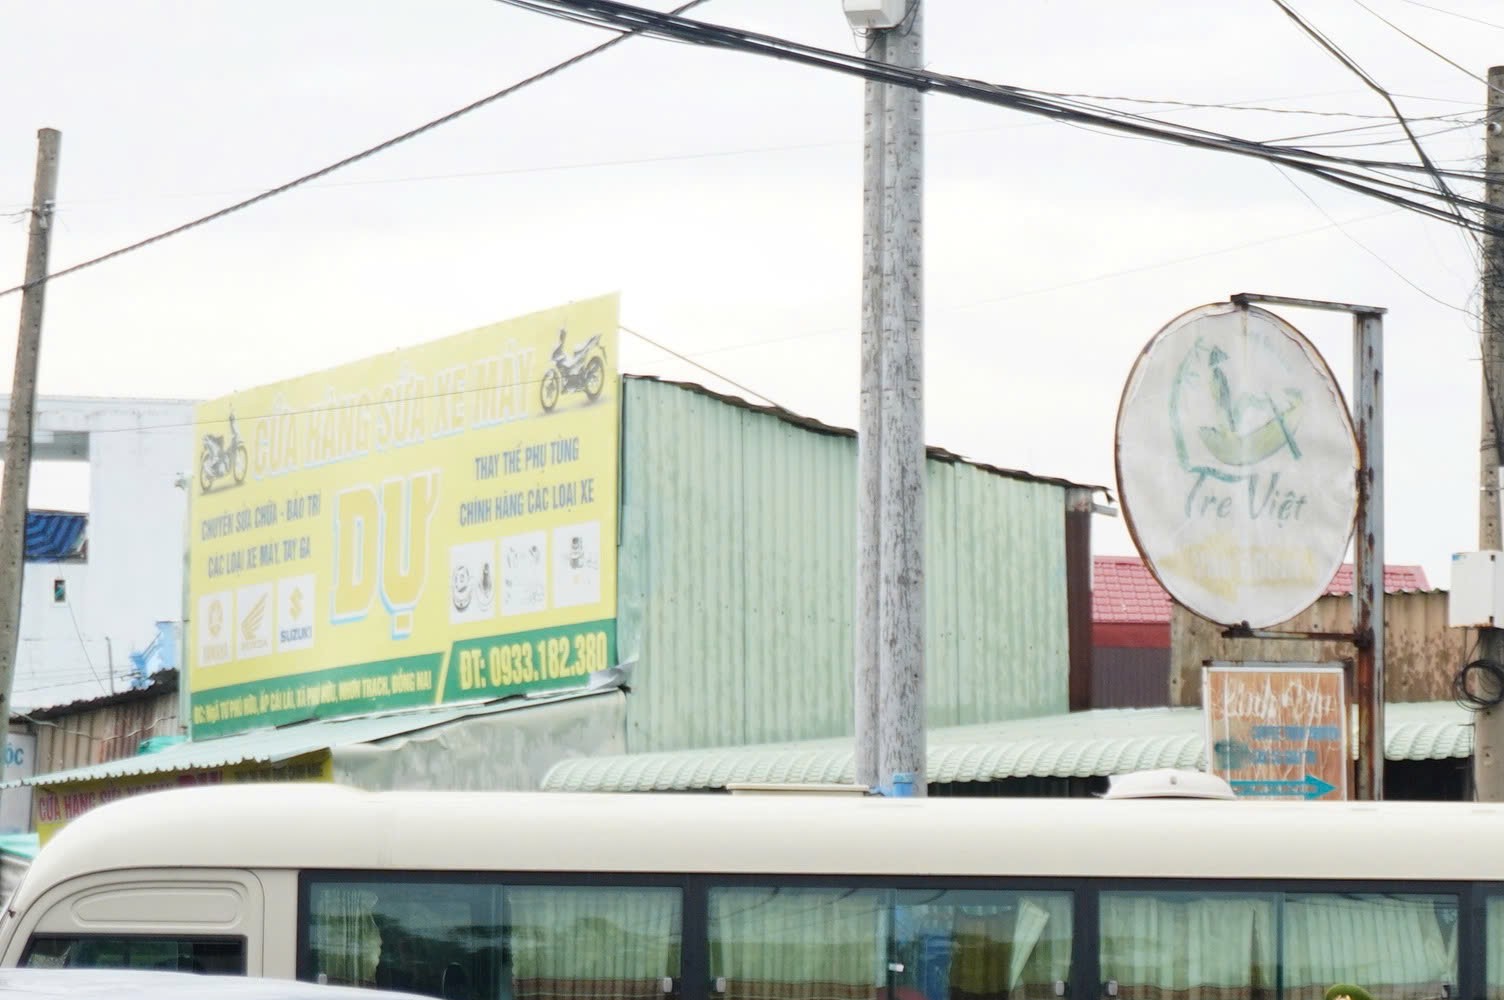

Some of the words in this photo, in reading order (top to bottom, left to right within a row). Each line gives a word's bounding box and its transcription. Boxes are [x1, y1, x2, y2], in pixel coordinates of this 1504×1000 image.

[474, 453, 500, 481] THAY
[580, 477, 595, 504] XE
[329, 466, 442, 640] DỰ
[489, 631, 608, 687] 0933.182.380
